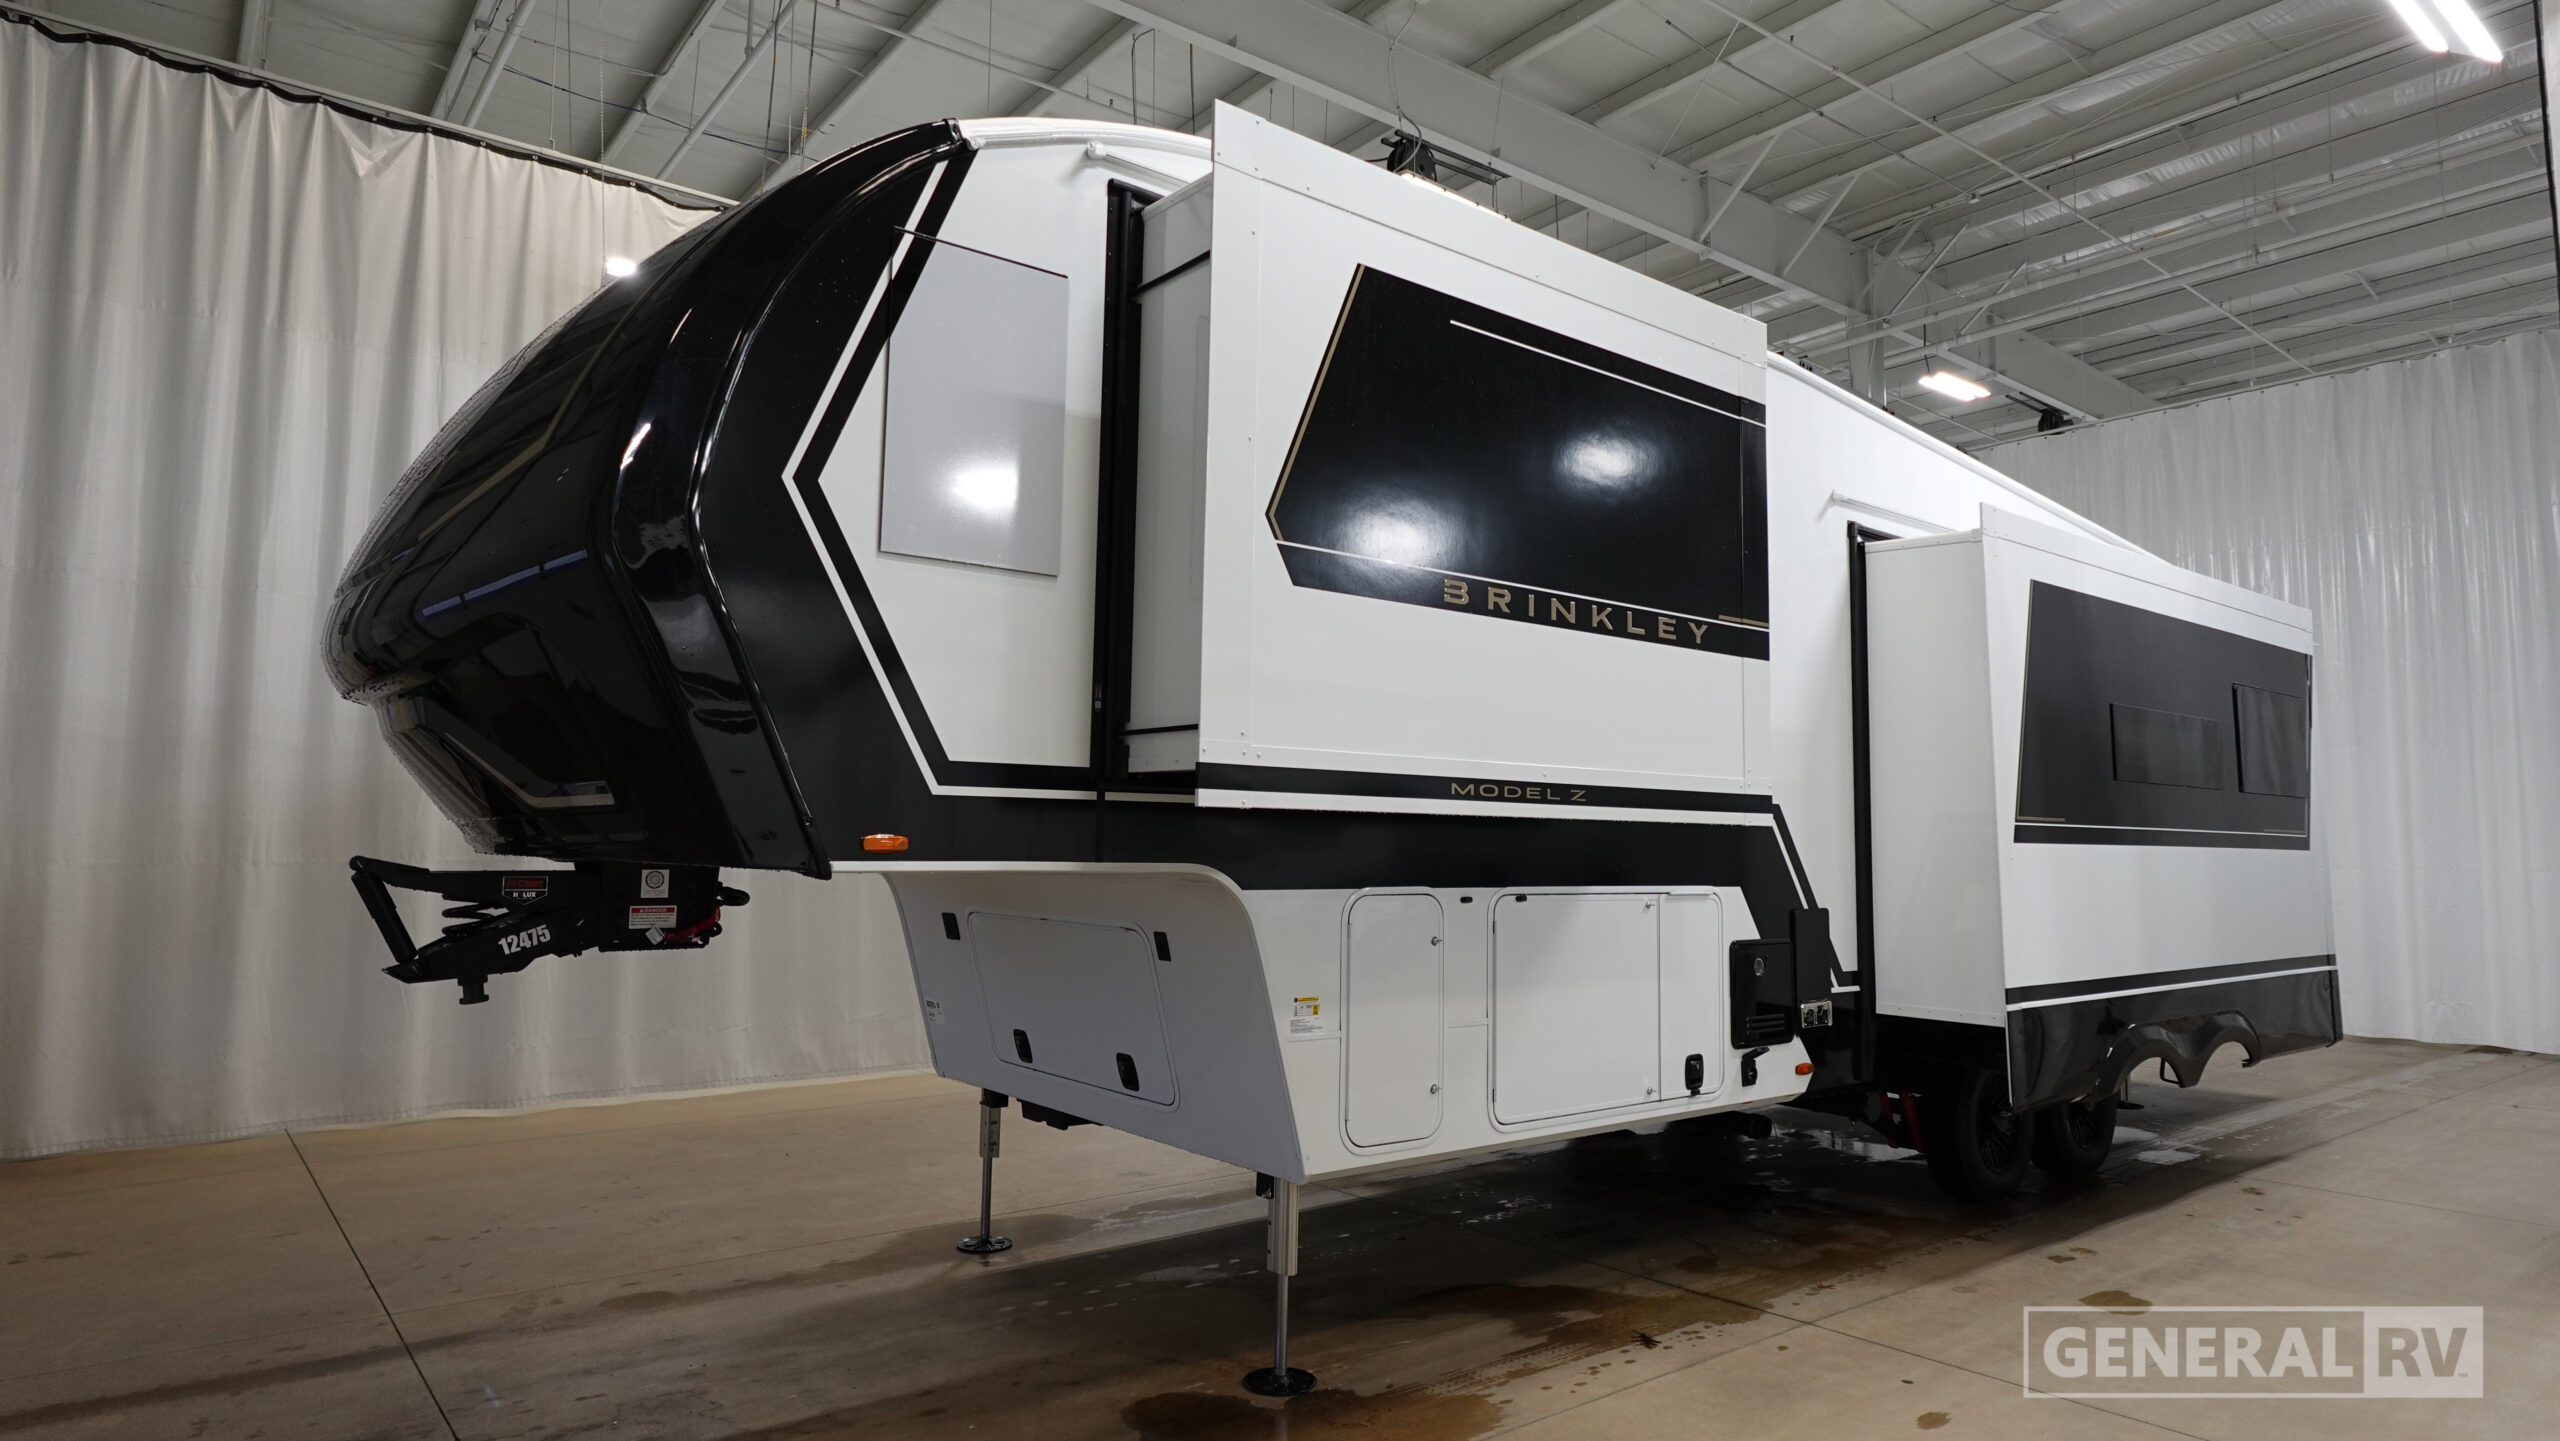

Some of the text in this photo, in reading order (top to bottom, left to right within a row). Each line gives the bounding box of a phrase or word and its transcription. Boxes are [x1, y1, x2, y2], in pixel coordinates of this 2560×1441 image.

[1443, 578, 1709, 644] BRINKLEY
[1451, 782, 1586, 802] MODEL Z
[497, 924, 551, 956] 12475
